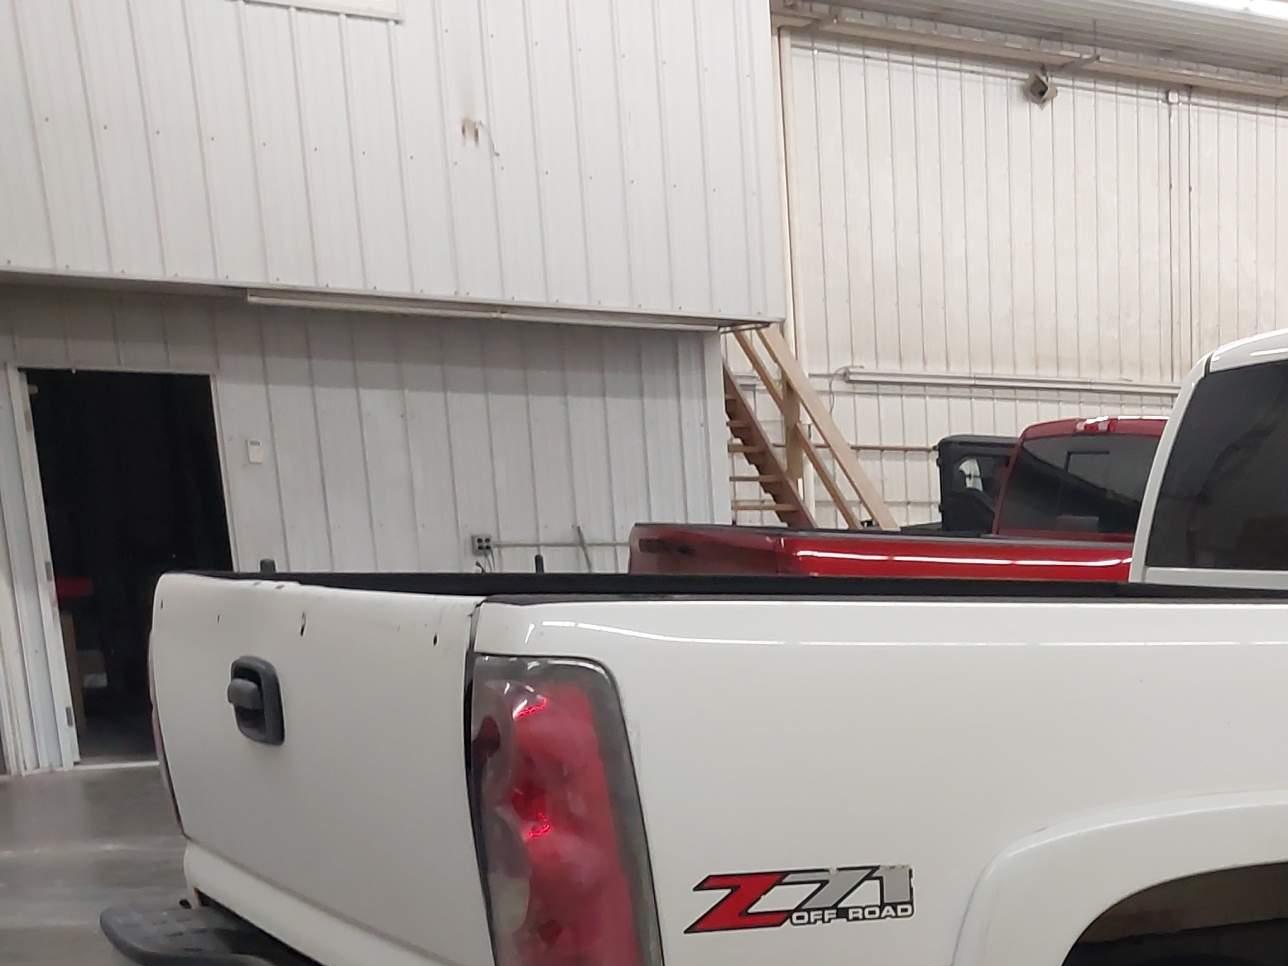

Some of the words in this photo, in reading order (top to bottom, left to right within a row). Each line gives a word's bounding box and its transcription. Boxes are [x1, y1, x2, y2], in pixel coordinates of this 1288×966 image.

[684, 865, 913, 934] Z71
[791, 907, 837, 925] OFF
[848, 903, 913, 921] ROAD
